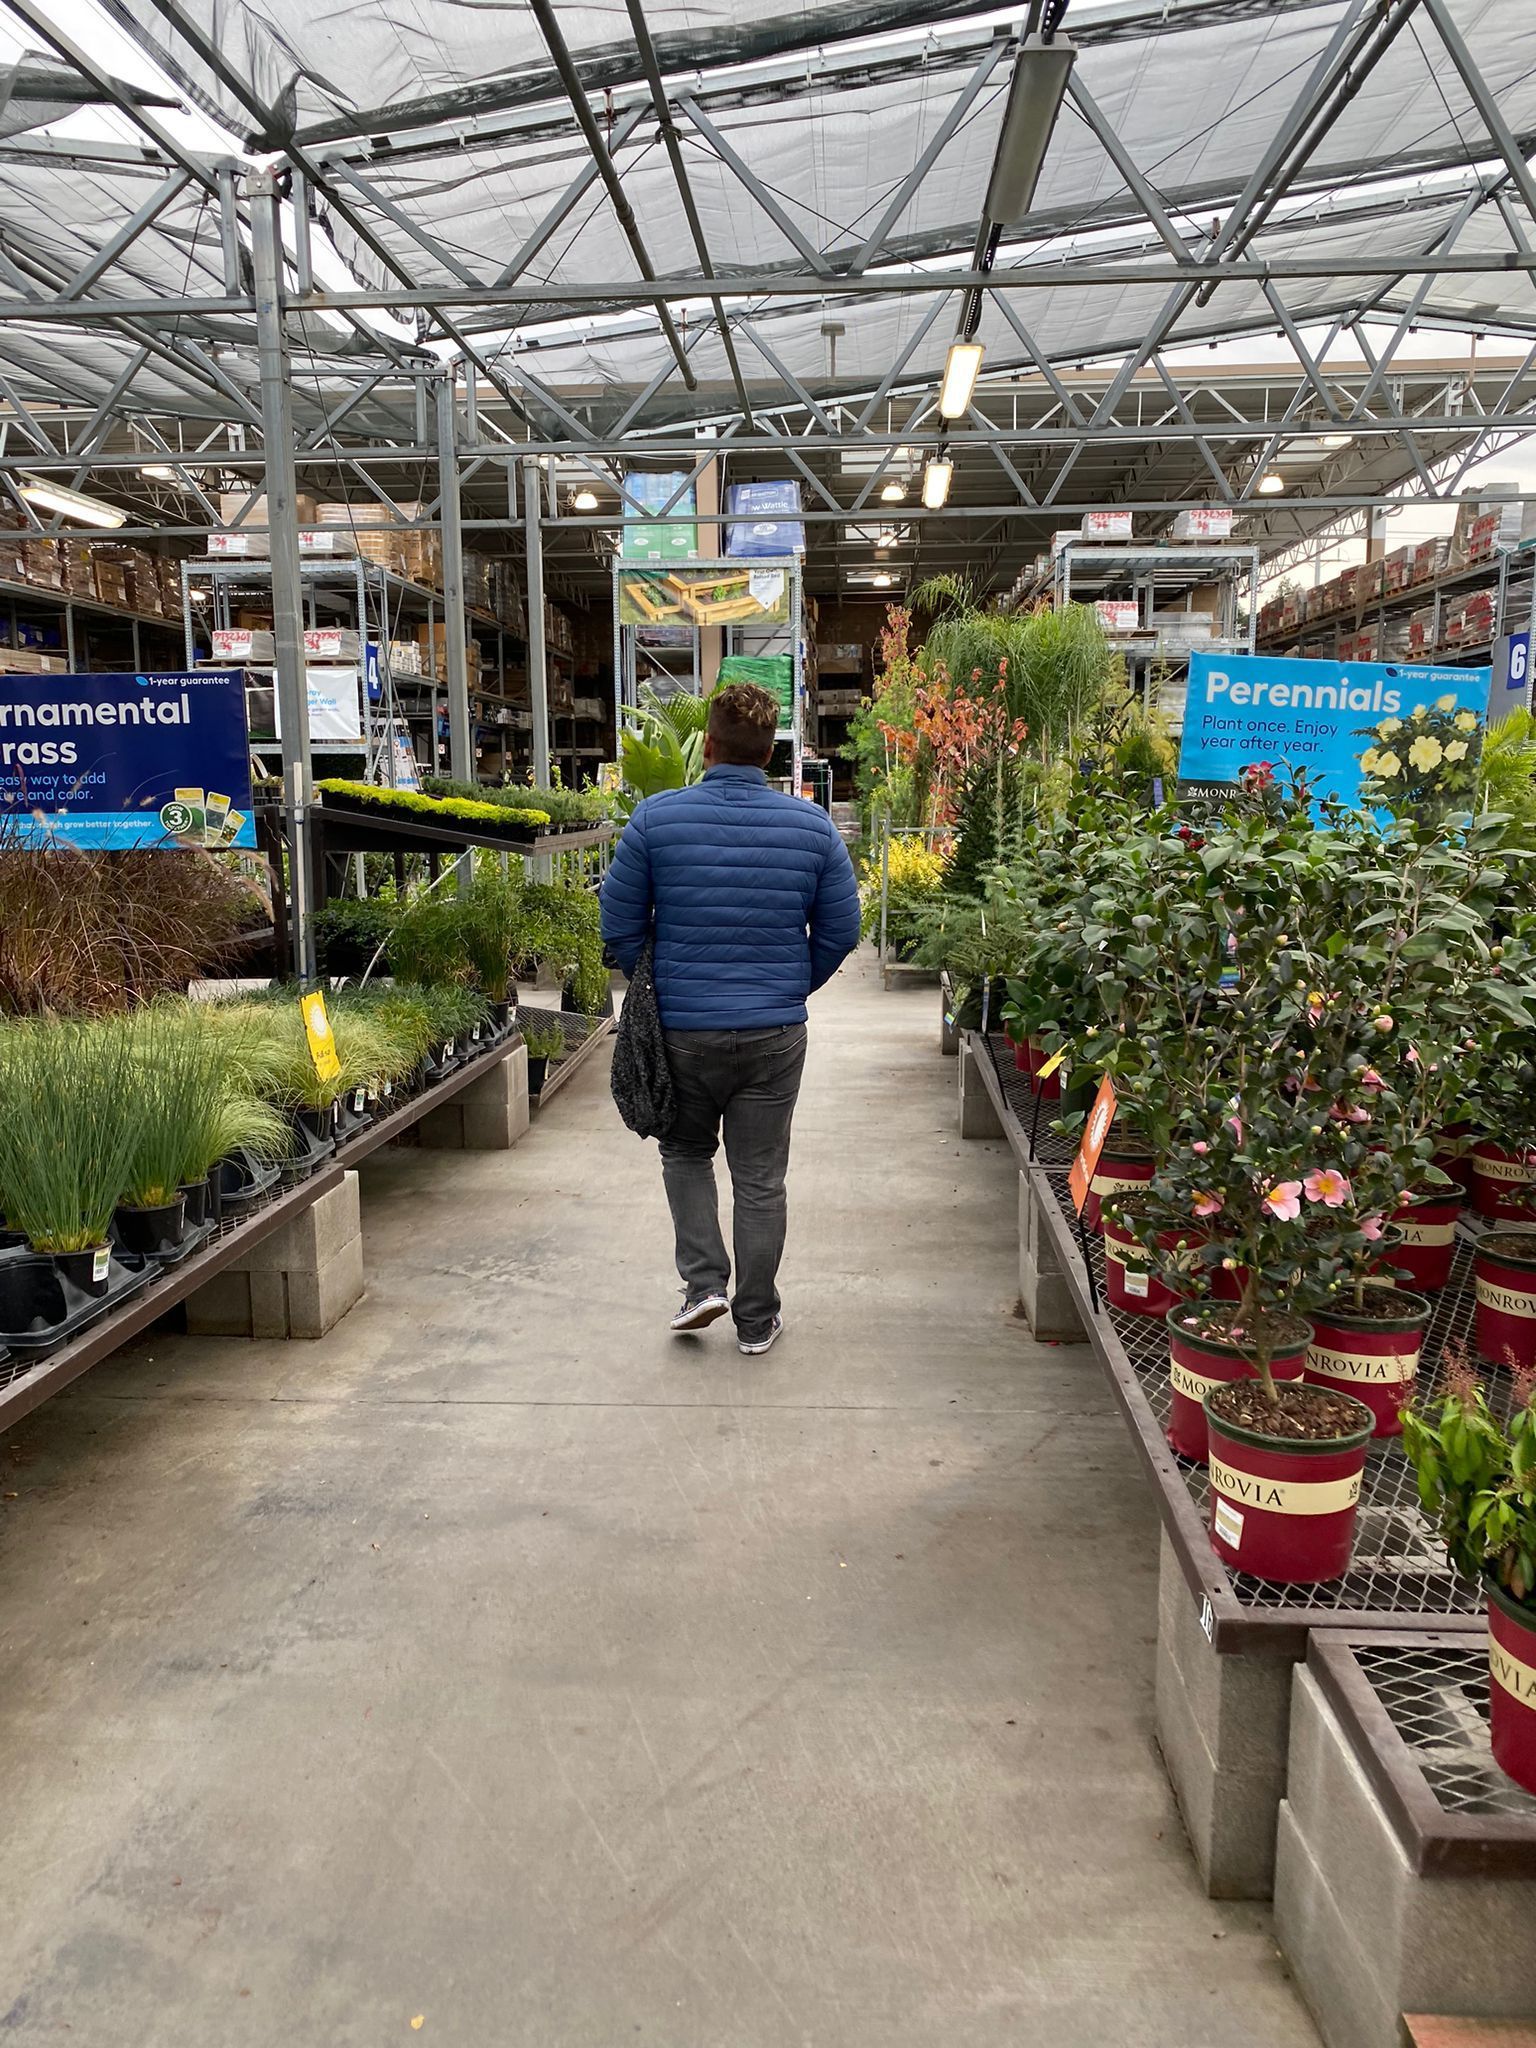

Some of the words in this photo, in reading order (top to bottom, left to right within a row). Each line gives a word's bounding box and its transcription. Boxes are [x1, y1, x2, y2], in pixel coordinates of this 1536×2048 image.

[1511, 643, 1527, 680] 6
[149, 676, 178, 687] 1-year
[180, 676, 230, 686] guarantee
[368, 656, 379, 690] 4
[1399, 668, 1429, 681] 1-year
[1430, 671, 1481, 683] guarantee
[1206, 671, 1402, 714] Perennials
[0, 693, 191, 727] rnamental
[1202, 715, 1243, 731] Plant
[1246, 719, 1291, 734] once.
[1295, 721, 1339, 739] Enjoy
[2, 741, 78, 765] rass
[1200, 736, 1236, 751] year
[1239, 736, 1280, 752] after
[1283, 740, 1325, 755] year.
[30, 776, 60, 788] way
[63, 773, 77, 785] to
[80, 772, 106, 785] add
[27, 789, 55, 801] and
[57, 789, 95, 801] color.
[64, 821, 85, 831] grow
[86, 820, 111, 829] better
[113, 820, 155, 831] together.
[168, 810, 183, 826] 3
